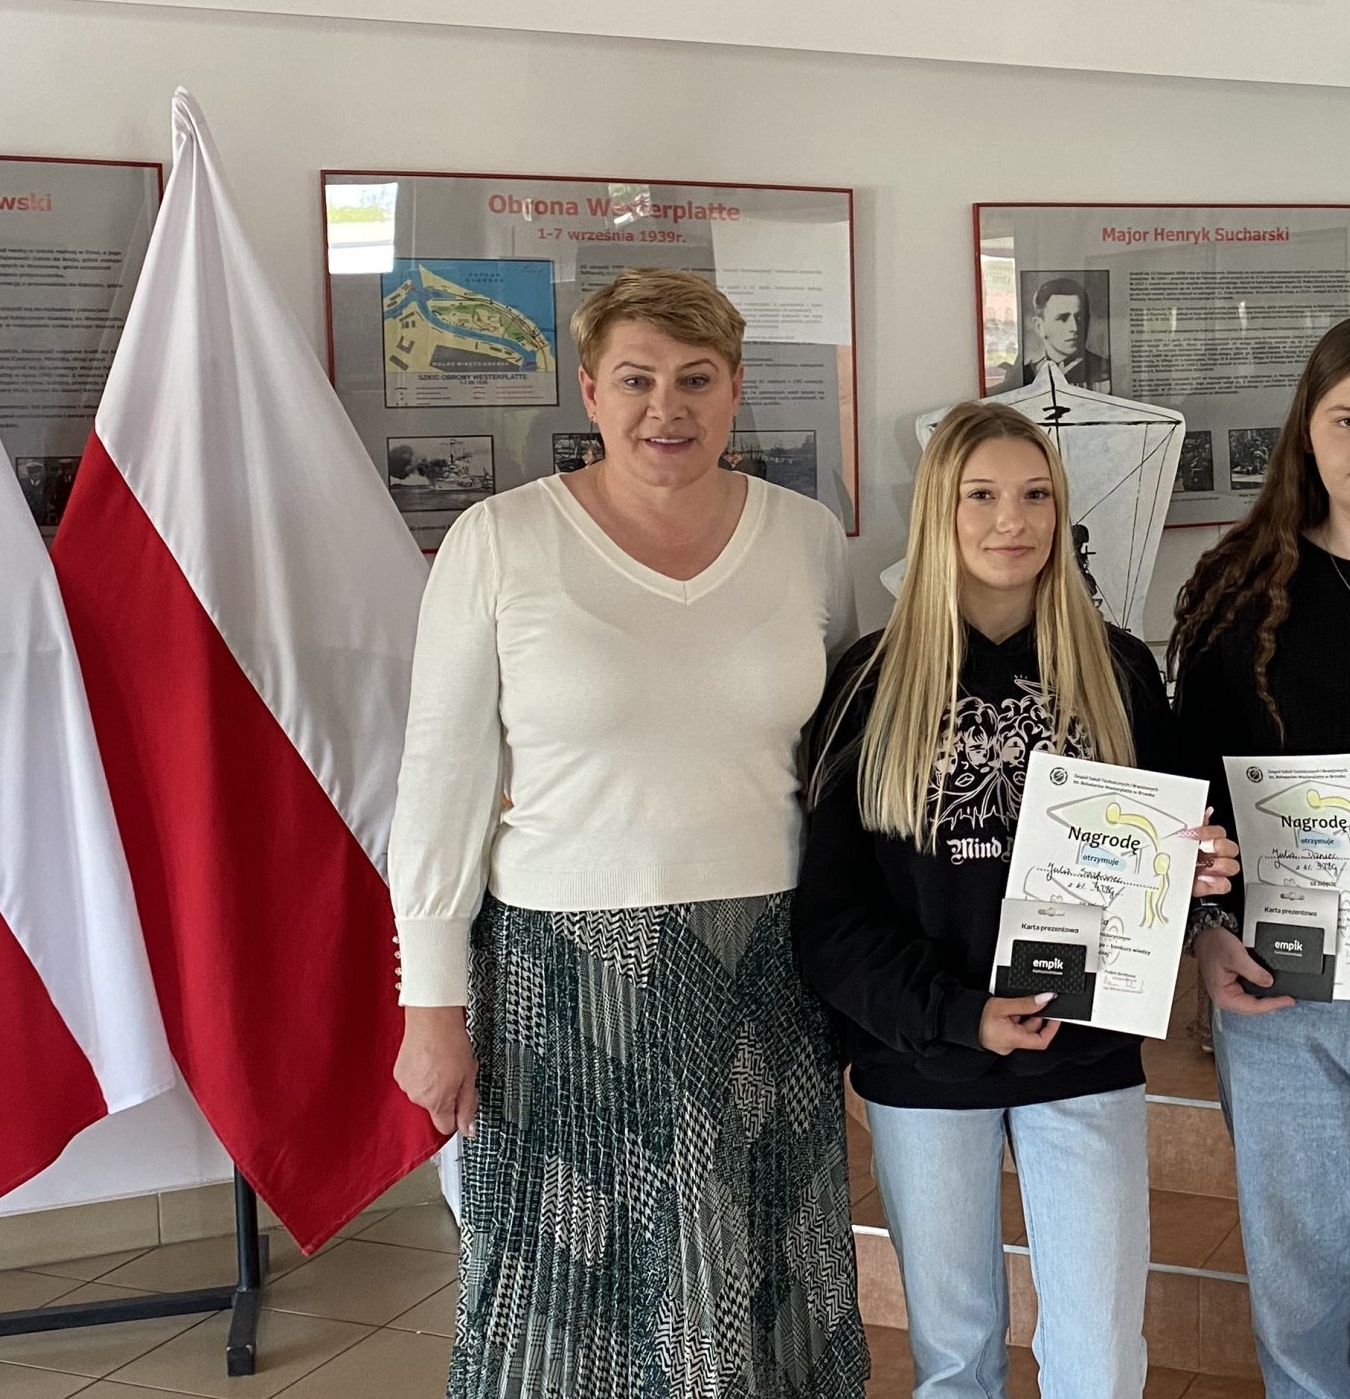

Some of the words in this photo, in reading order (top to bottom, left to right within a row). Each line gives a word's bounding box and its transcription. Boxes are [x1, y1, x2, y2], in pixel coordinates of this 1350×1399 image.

[488, 194, 578, 216] Obrona
[537, 228, 562, 239] 1-7
[568, 228, 634, 241] września
[640, 230, 686, 243] 1939r.
[1102, 227, 1149, 245] Major
[1154, 227, 1210, 244] Henryk
[1215, 227, 1290, 242] Sucharski
[1281, 815, 1347, 833] Nagrodę
[1068, 826, 1140, 855] Nagrodę
[1300, 838, 1334, 846] otrzymuje
[946, 836, 1002, 865] Mind
[1082, 853, 1119, 866] otrzymuje
[1264, 906, 1281, 914] Karta
[1021, 923, 1040, 931] Karta
[1040, 925, 1079, 933] prezentowa
[1274, 940, 1303, 951] empik
[1032, 957, 1064, 970] empik
